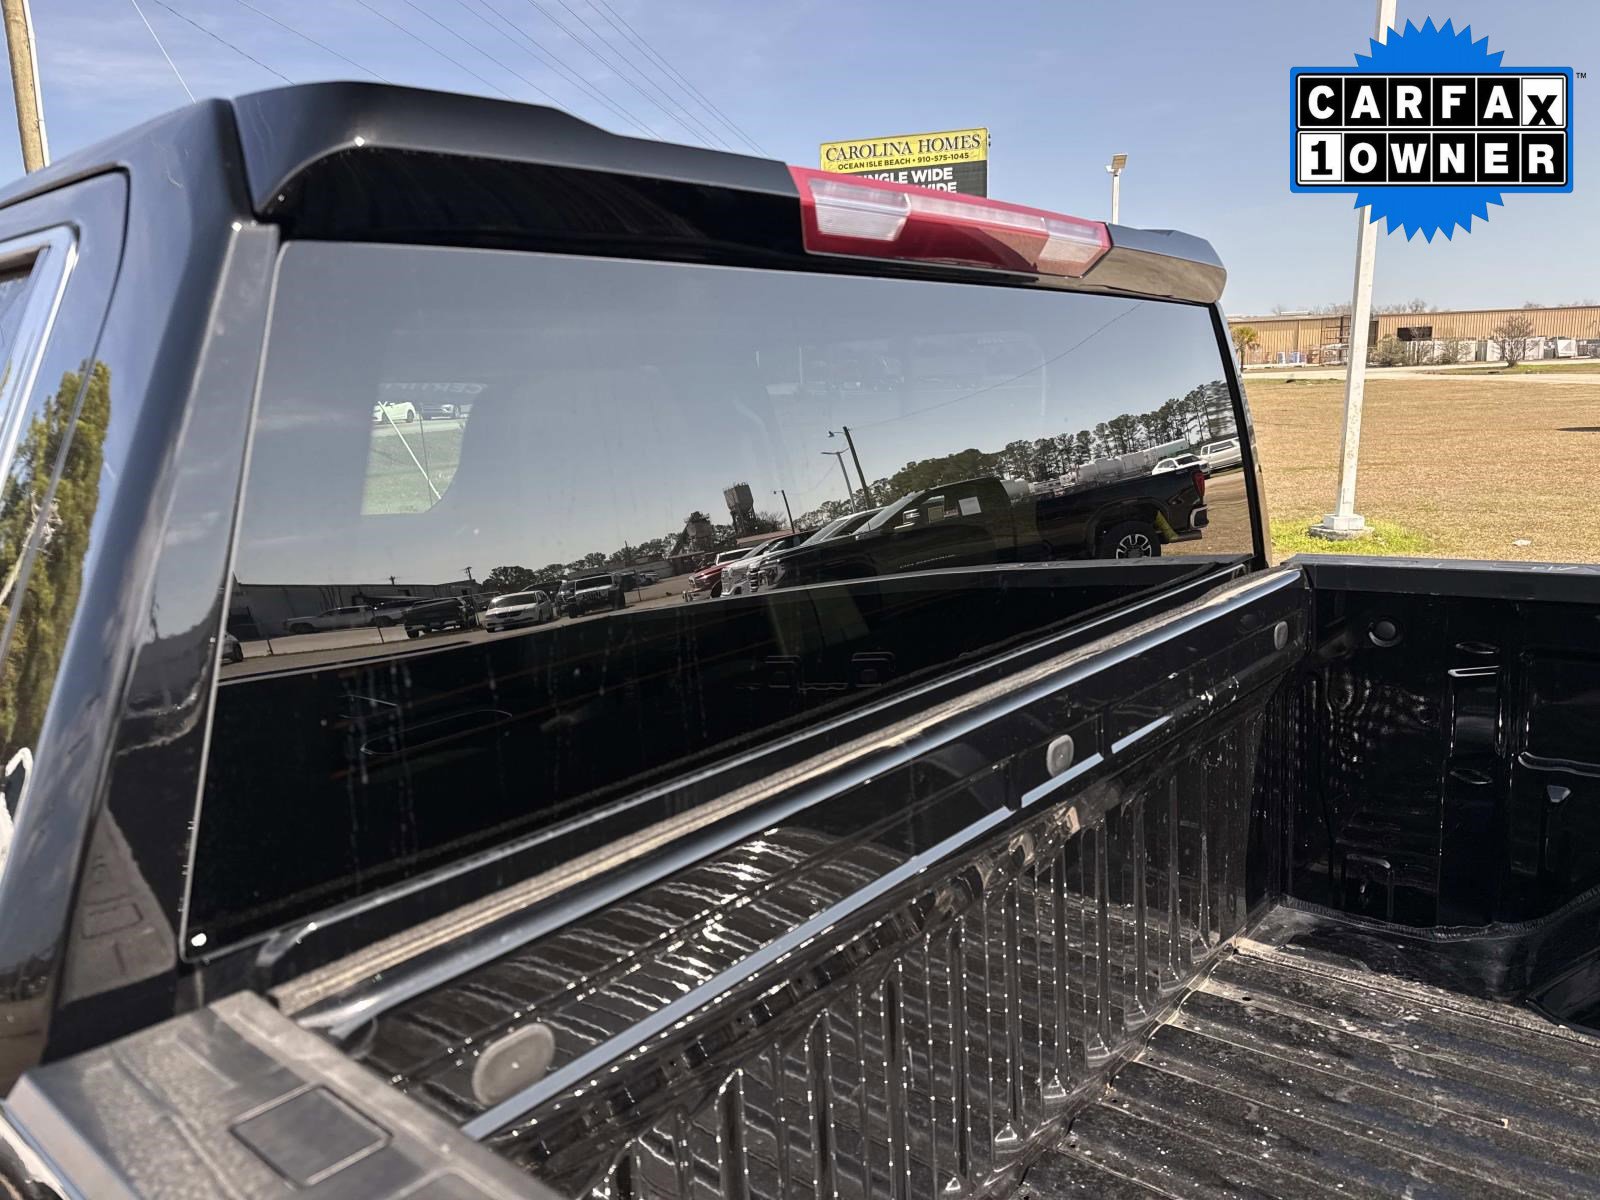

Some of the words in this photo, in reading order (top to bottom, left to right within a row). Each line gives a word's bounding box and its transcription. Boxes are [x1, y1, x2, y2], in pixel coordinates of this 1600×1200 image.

[826, 141, 912, 161] CAROLINA
[919, 134, 981, 153] HOMES
[838, 161, 865, 170] OCEAN
[866, 160, 882, 169] ISLE
[884, 158, 911, 166] BEACH
[917, 152, 969, 163] 910-575-1045
[911, 167, 953, 183] WIDE
